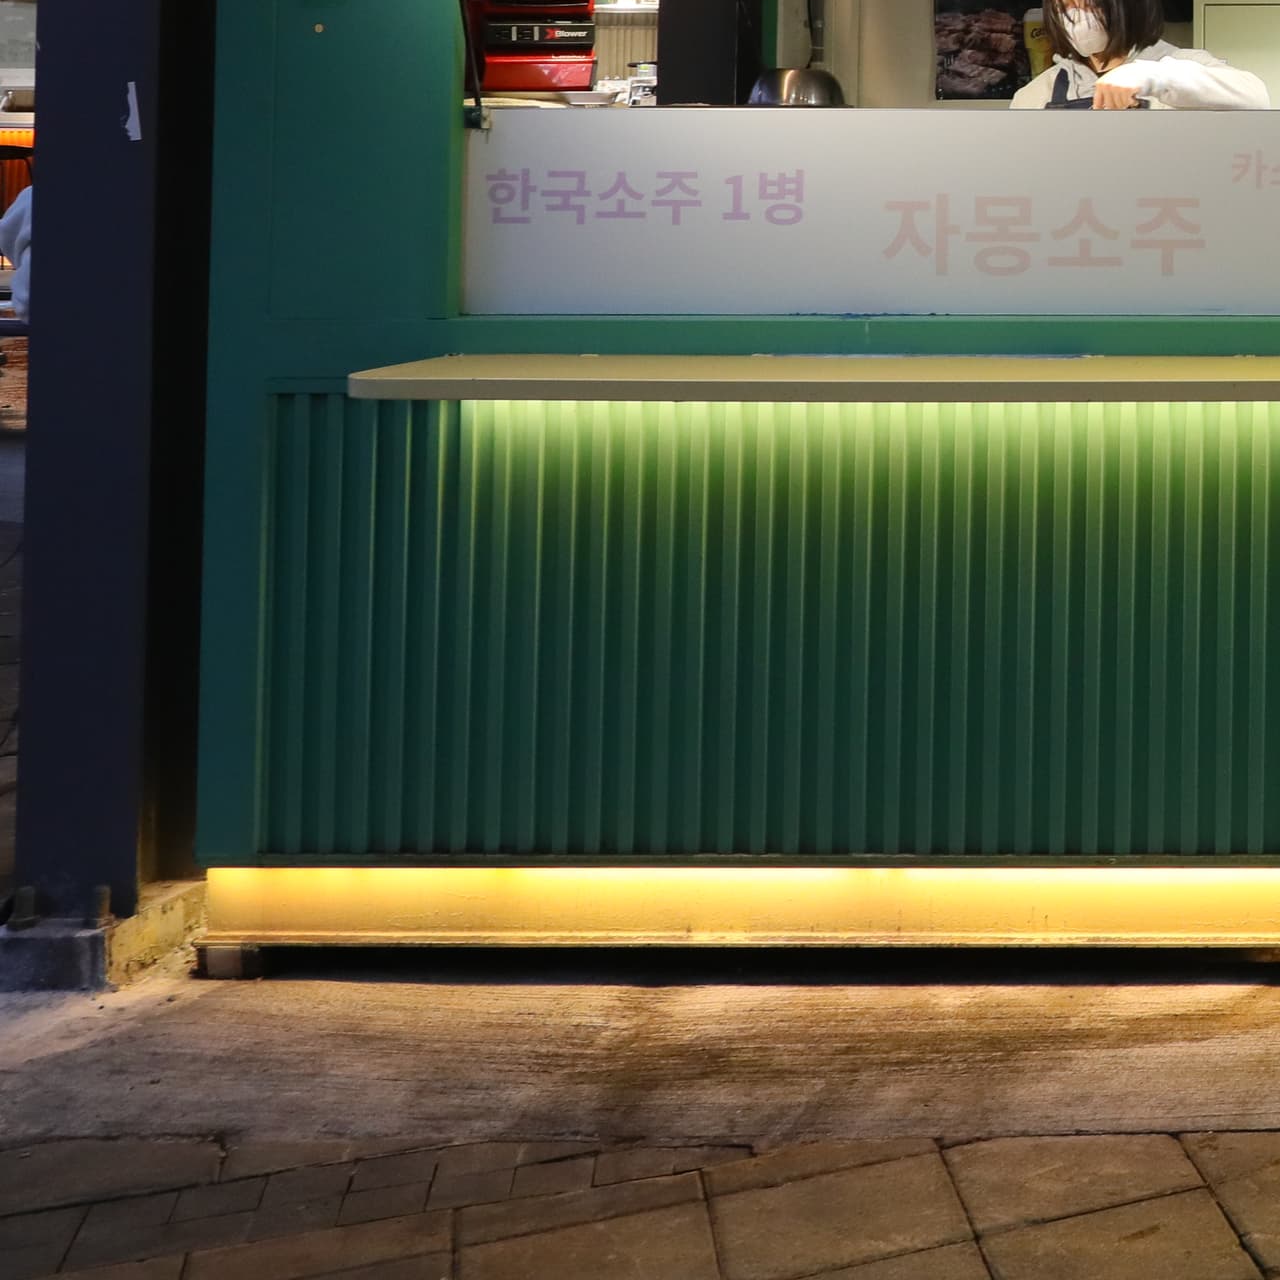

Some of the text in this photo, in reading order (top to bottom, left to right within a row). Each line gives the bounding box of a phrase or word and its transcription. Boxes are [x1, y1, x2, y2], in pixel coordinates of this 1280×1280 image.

[485, 168, 808, 226] 한국소주 1병
[882, 191, 1207, 278] 자몽소주
